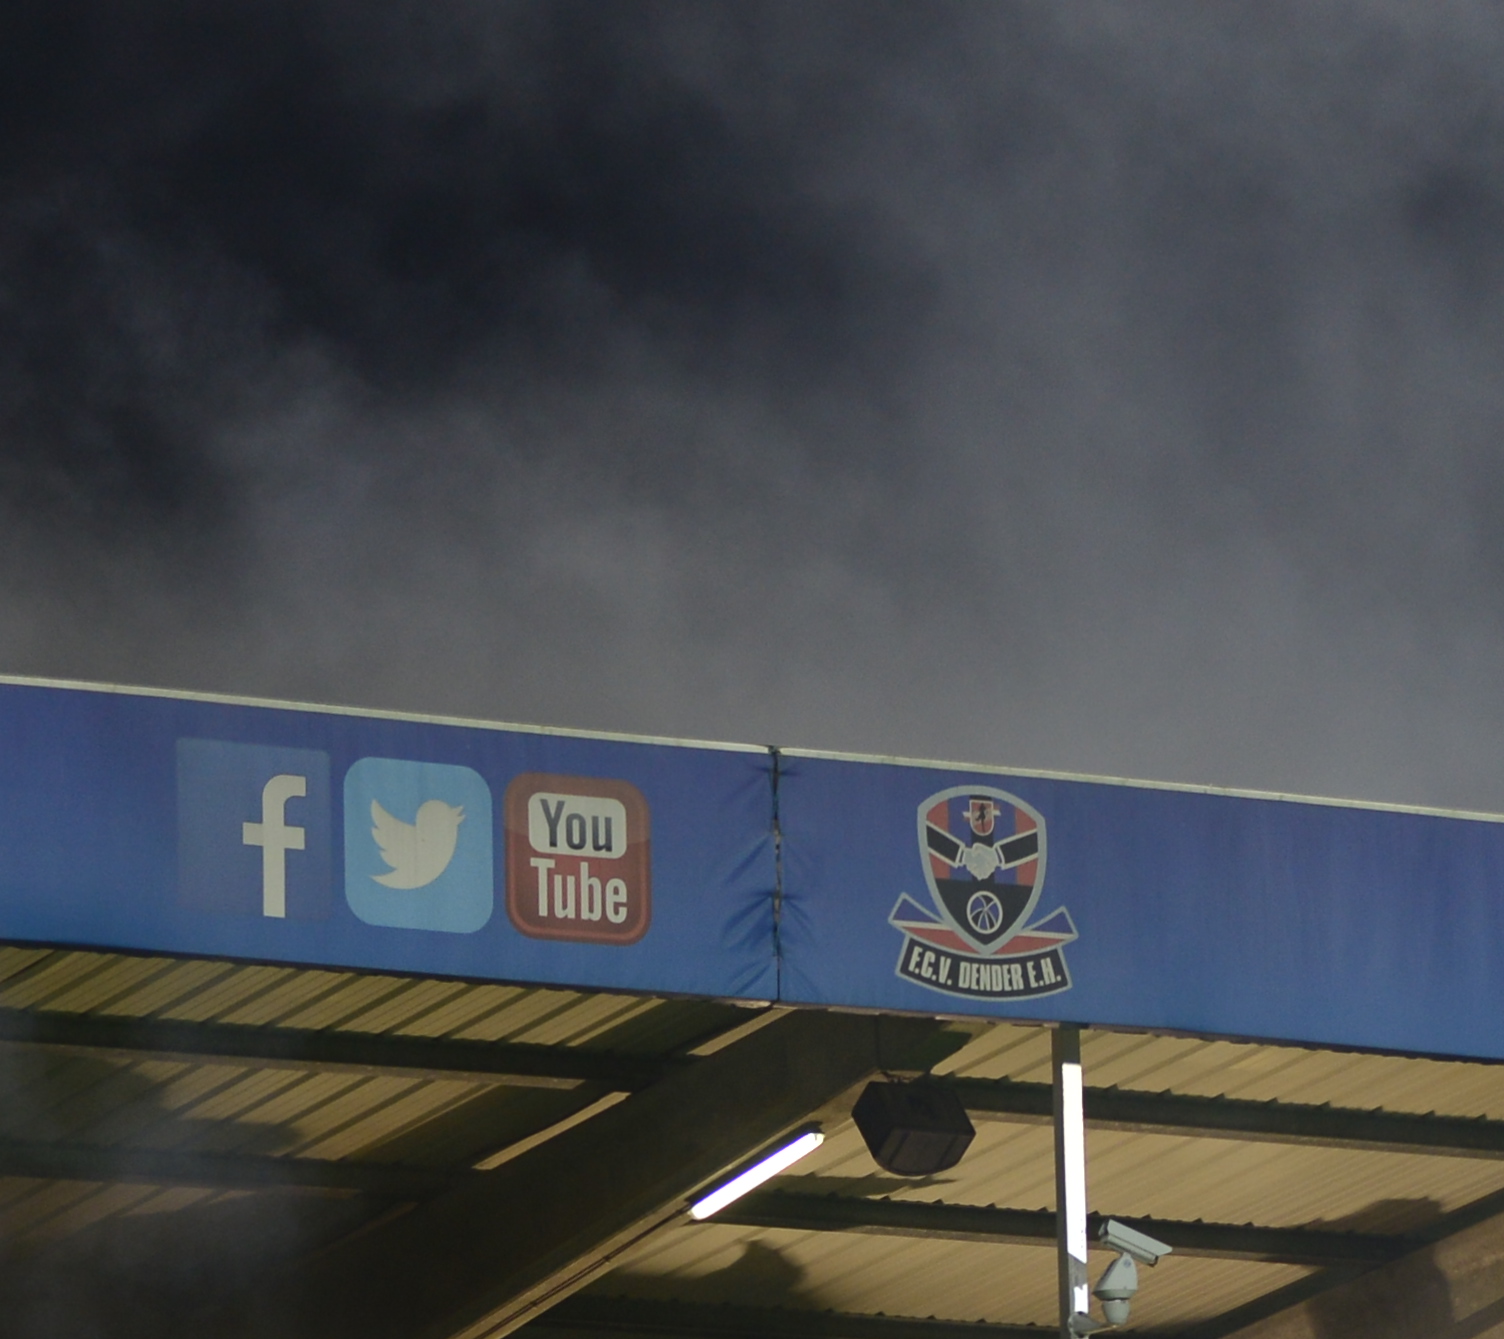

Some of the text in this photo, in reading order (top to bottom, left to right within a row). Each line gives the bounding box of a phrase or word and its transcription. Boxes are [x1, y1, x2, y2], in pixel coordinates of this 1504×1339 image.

[540, 799, 613, 853] You
[530, 856, 628, 924] Tube
[907, 945, 1062, 992] F.C.V. DENDER E.H.
